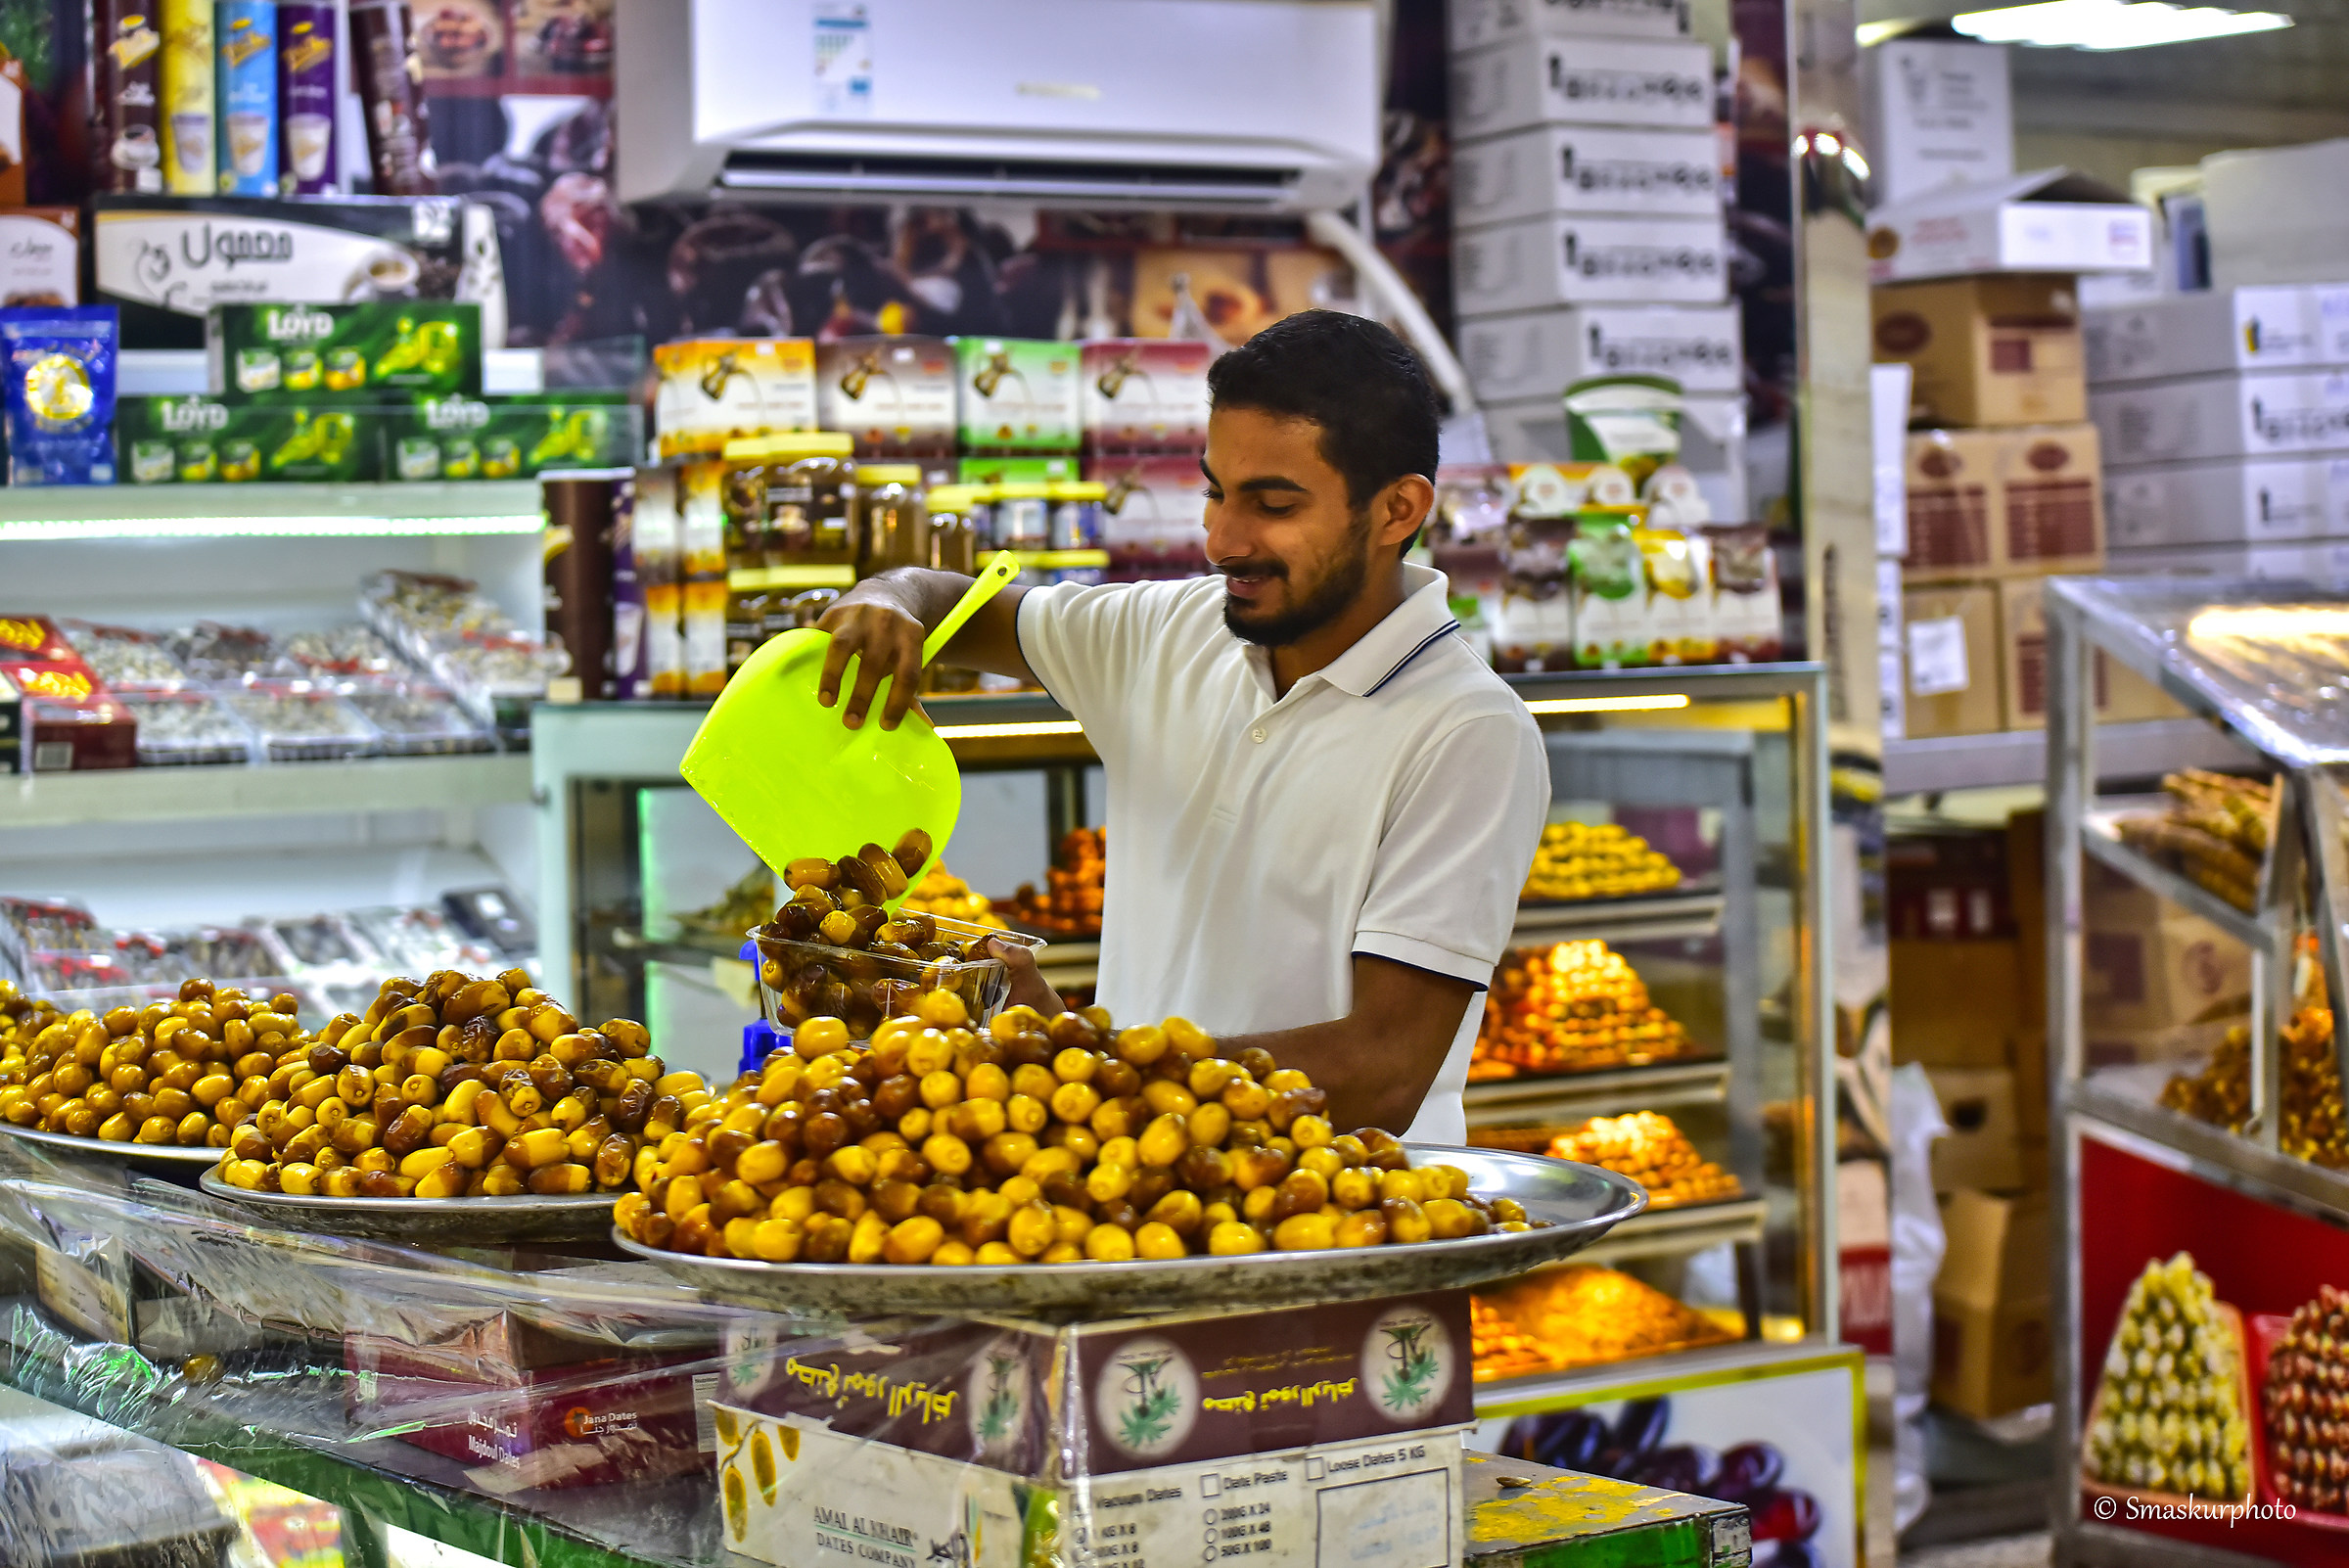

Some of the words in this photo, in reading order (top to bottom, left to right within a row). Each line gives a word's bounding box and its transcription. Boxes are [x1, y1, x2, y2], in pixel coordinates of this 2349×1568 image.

[181, 221, 294, 271] معمول
[267, 309, 335, 340] LOYD
[161, 399, 229, 431] LOYD
[425, 397, 490, 430] LOYD
[583, 1414, 607, 1425] Jana
[608, 1411, 638, 1422] Dates
[468, 1434, 498, 1460] Majdoul
[498, 1446, 521, 1468] Dates
[1363, 1452, 1396, 1467] Dates
[1398, 1449, 1406, 1461] 5
[1409, 1445, 1426, 1459] KG
[1223, 1476, 1252, 1491] Date
[1254, 1470, 1288, 1486] Paste
[1145, 1487, 1182, 1502] Dates
[852, 1516, 869, 1536] AL
[815, 1532, 854, 1554] DATES
